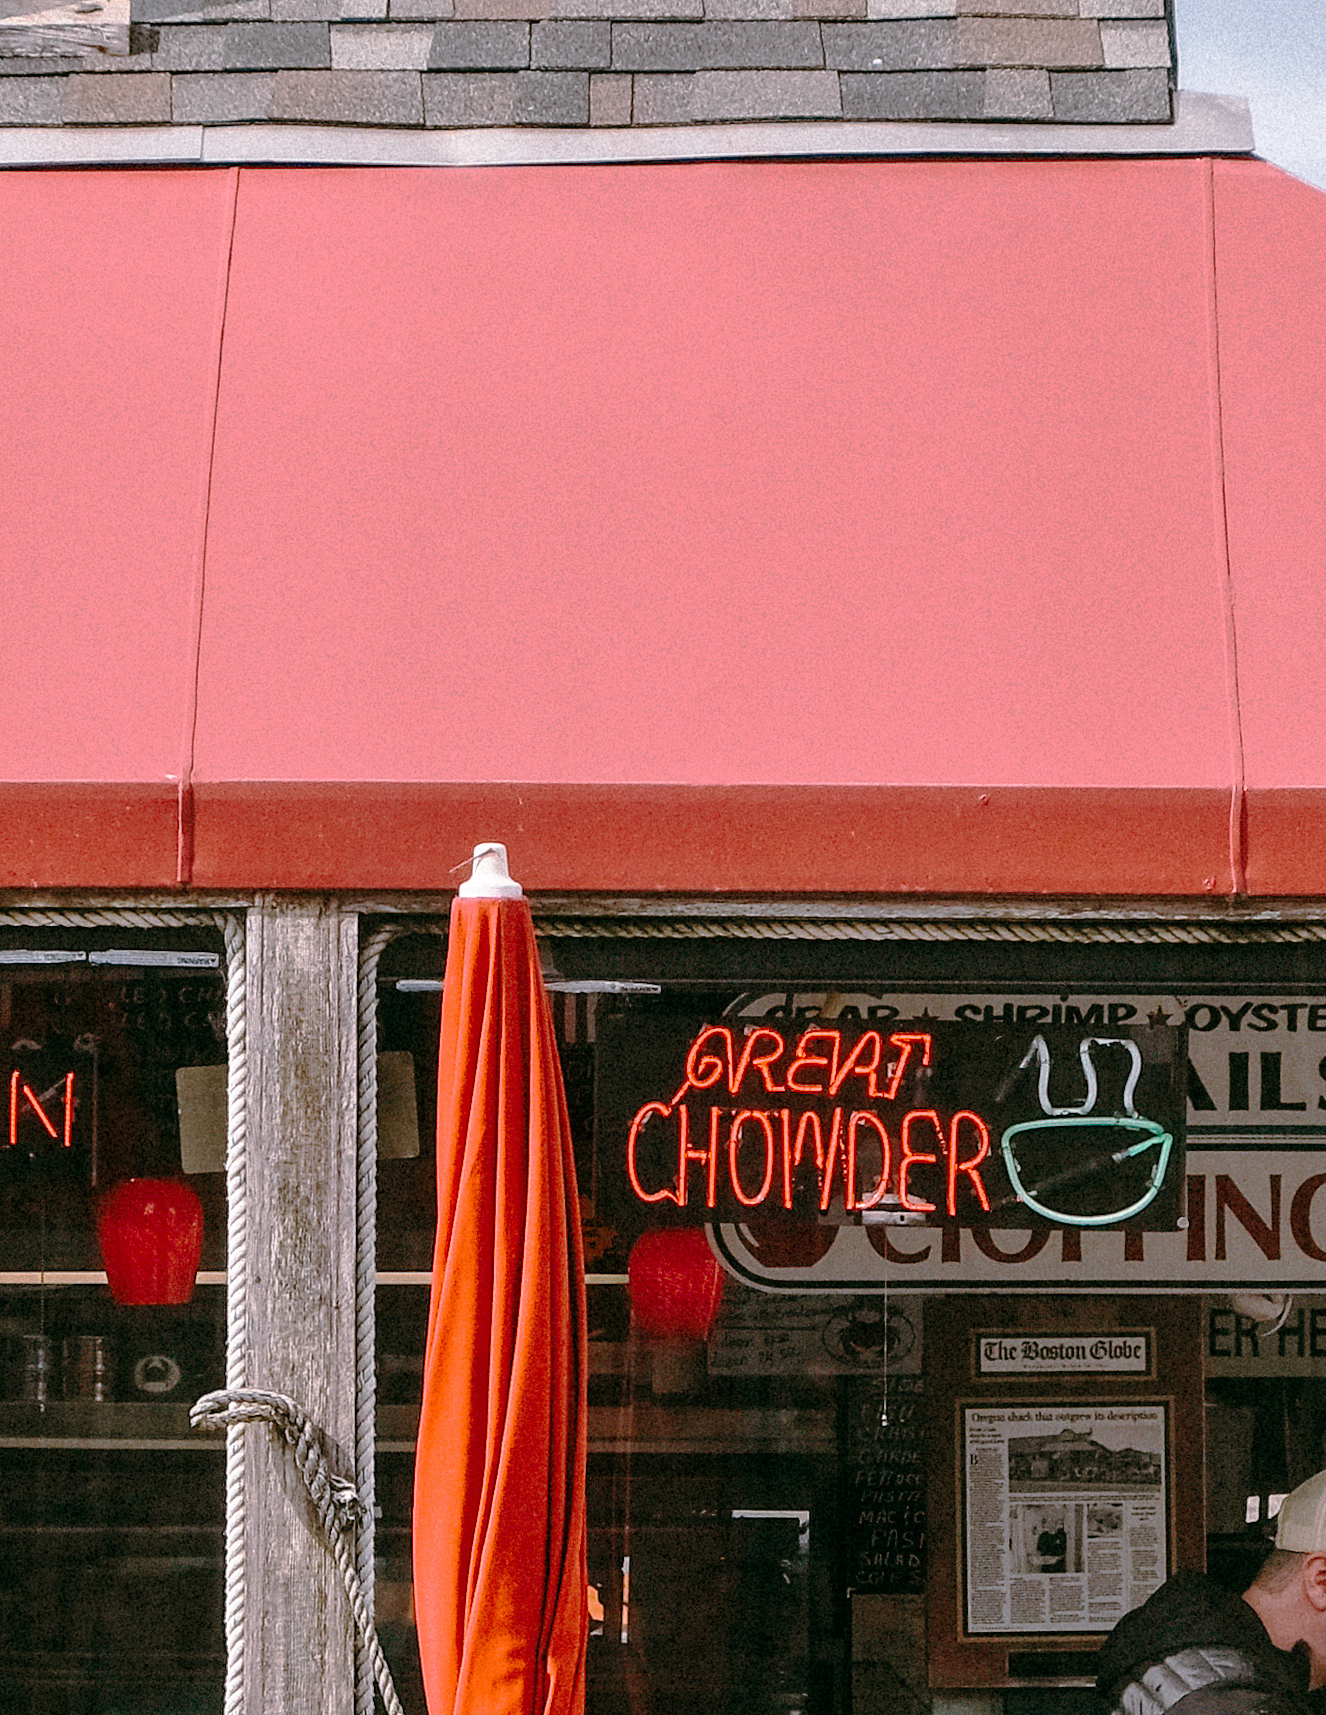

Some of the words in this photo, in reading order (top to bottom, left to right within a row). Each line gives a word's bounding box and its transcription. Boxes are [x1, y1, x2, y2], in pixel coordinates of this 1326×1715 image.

[672, 1025, 932, 1104] GREAT
[627, 1101, 991, 1216] CHOWDER
[983, 1340, 1017, 1362] The
[1021, 1339, 1087, 1361] Boston
[1089, 1339, 1142, 1360] Globe
[1035, 1411, 1053, 1421] that
[1107, 1410, 1158, 1423] description
